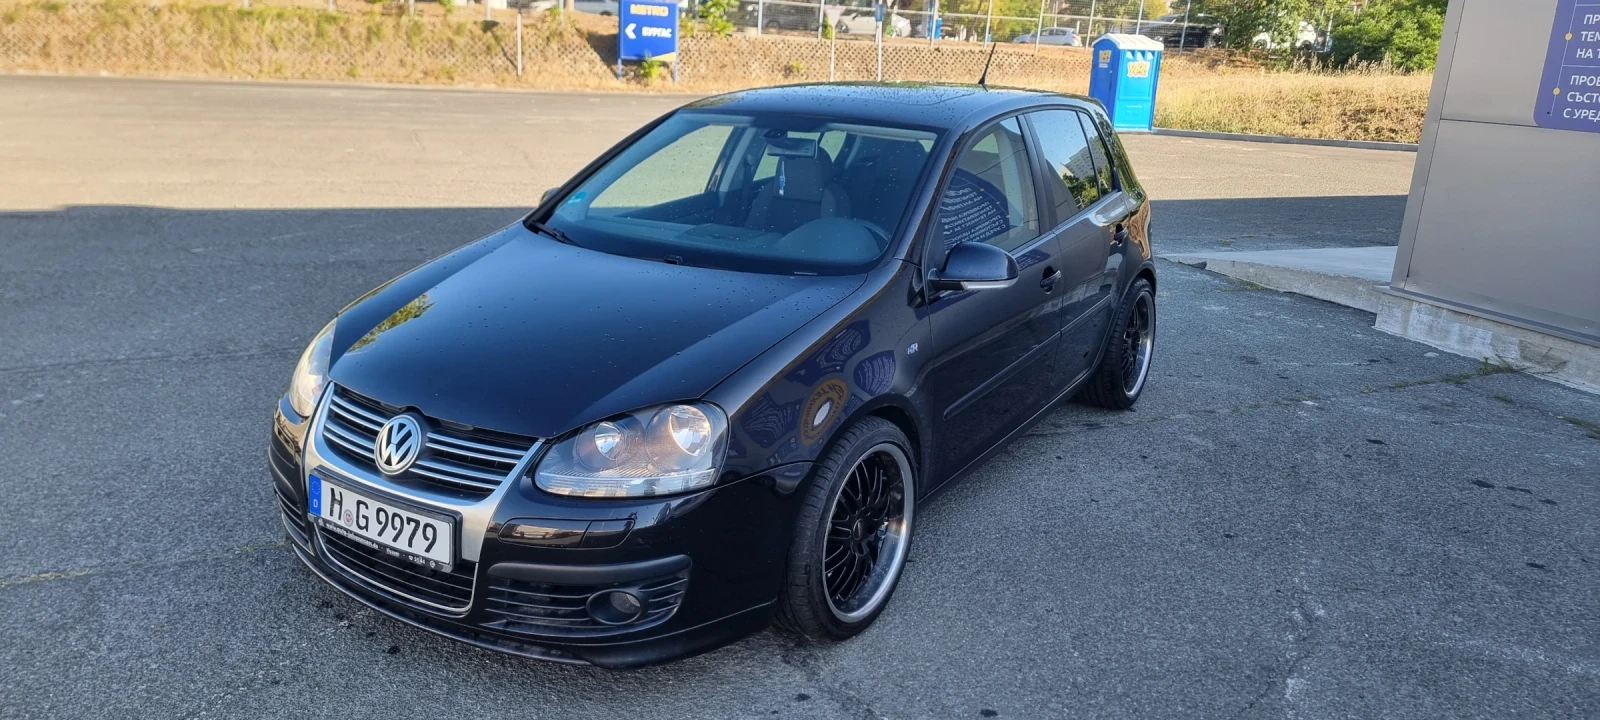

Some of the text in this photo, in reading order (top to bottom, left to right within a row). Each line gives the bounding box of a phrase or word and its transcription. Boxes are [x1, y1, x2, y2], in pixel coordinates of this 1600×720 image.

[630, 4, 669, 16] METRO
[642, 26, 672, 38] БУРГАС
[1576, 48, 1593, 58] НА
[1563, 107, 1571, 118] С
[377, 417, 419, 471] VW
[313, 498, 318, 508] D
[329, 487, 438, 554] H G 9979
